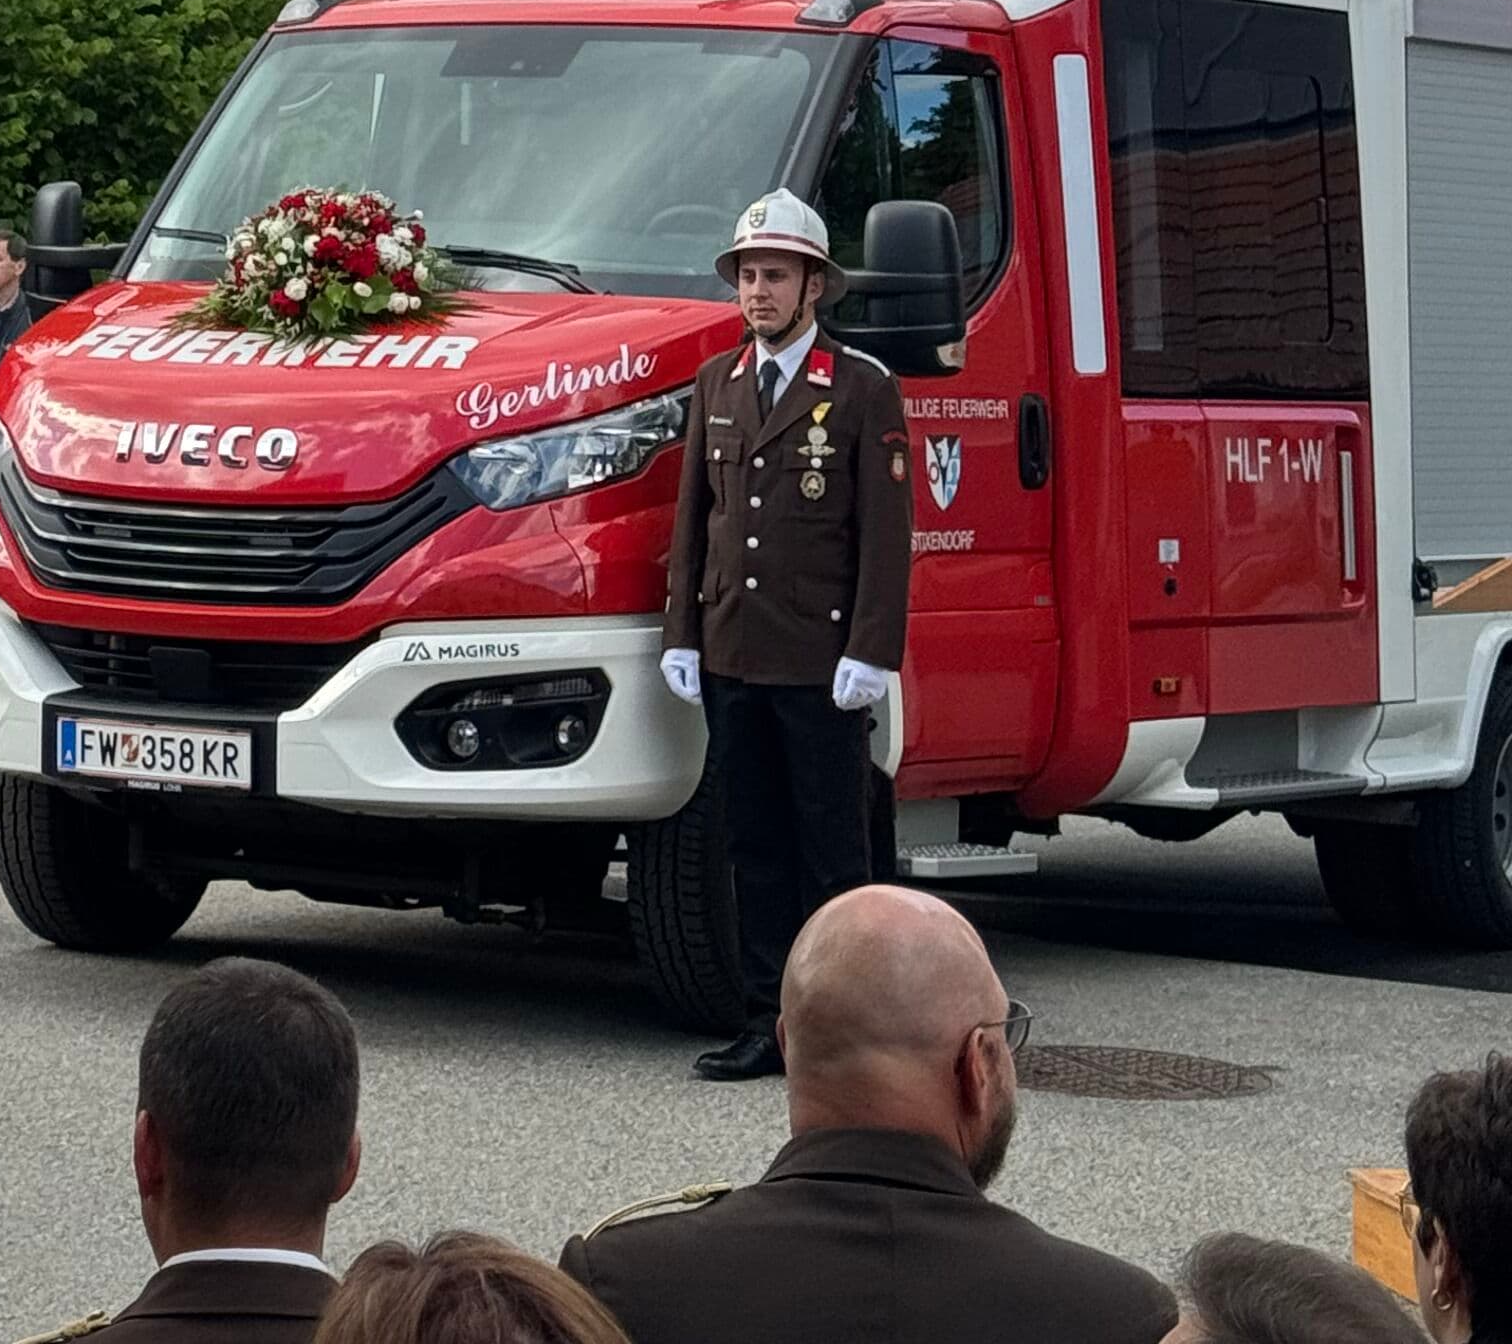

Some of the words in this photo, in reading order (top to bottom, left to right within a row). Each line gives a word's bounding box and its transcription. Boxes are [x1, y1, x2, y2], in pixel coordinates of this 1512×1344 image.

[53, 325, 481, 370] FEUERWEHR
[455, 343, 658, 430] Gerlinde
[942, 398, 1009, 419] FEUERWEHR
[115, 420, 300, 472] IVECO
[1225, 437, 1272, 484] HLF
[1278, 437, 1323, 484] 1-W
[911, 529, 975, 552] STIXENDORF
[438, 643, 520, 660] MAGIRUS
[80, 729, 119, 766] FW
